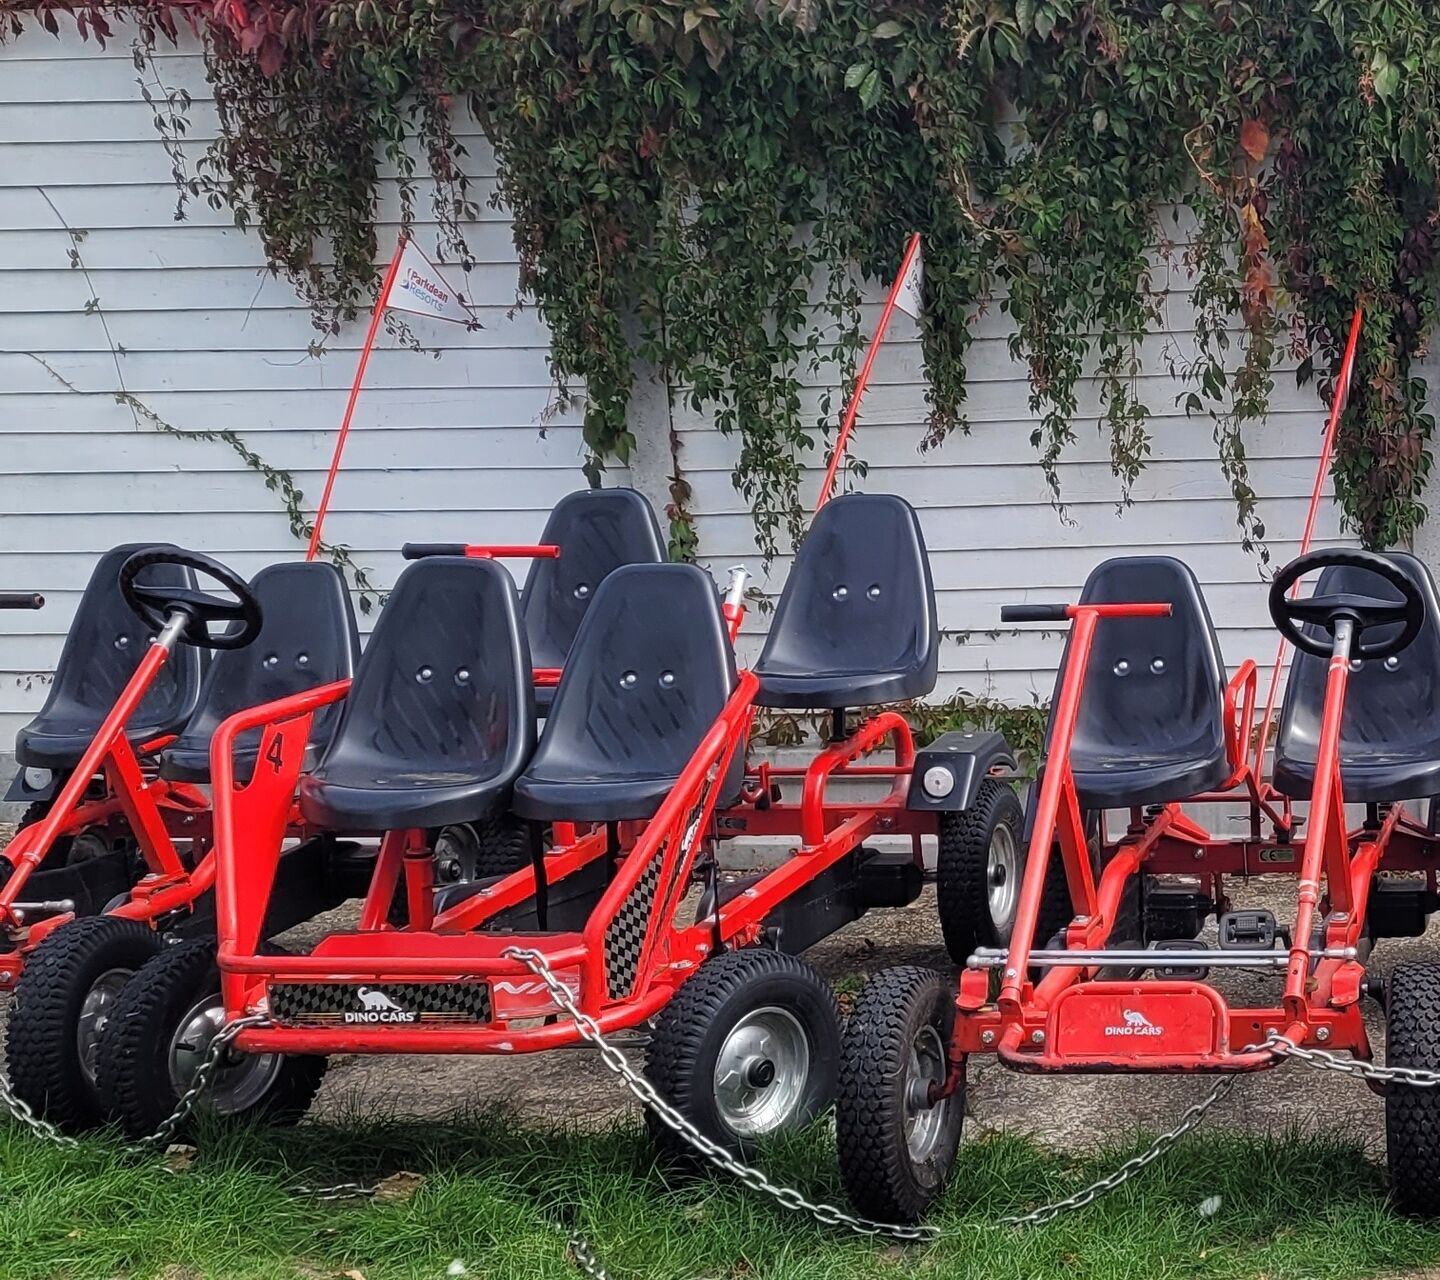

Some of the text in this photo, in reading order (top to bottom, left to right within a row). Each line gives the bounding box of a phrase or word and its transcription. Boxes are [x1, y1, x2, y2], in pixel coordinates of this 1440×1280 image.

[410, 282, 443, 311] Resorts
[411, 270, 448, 303] Parkdean
[266, 732, 284, 774] 4
[1259, 850, 1276, 861] CE
[344, 1012, 378, 1023] DINO
[1105, 1026, 1162, 1036] DINO CARS
